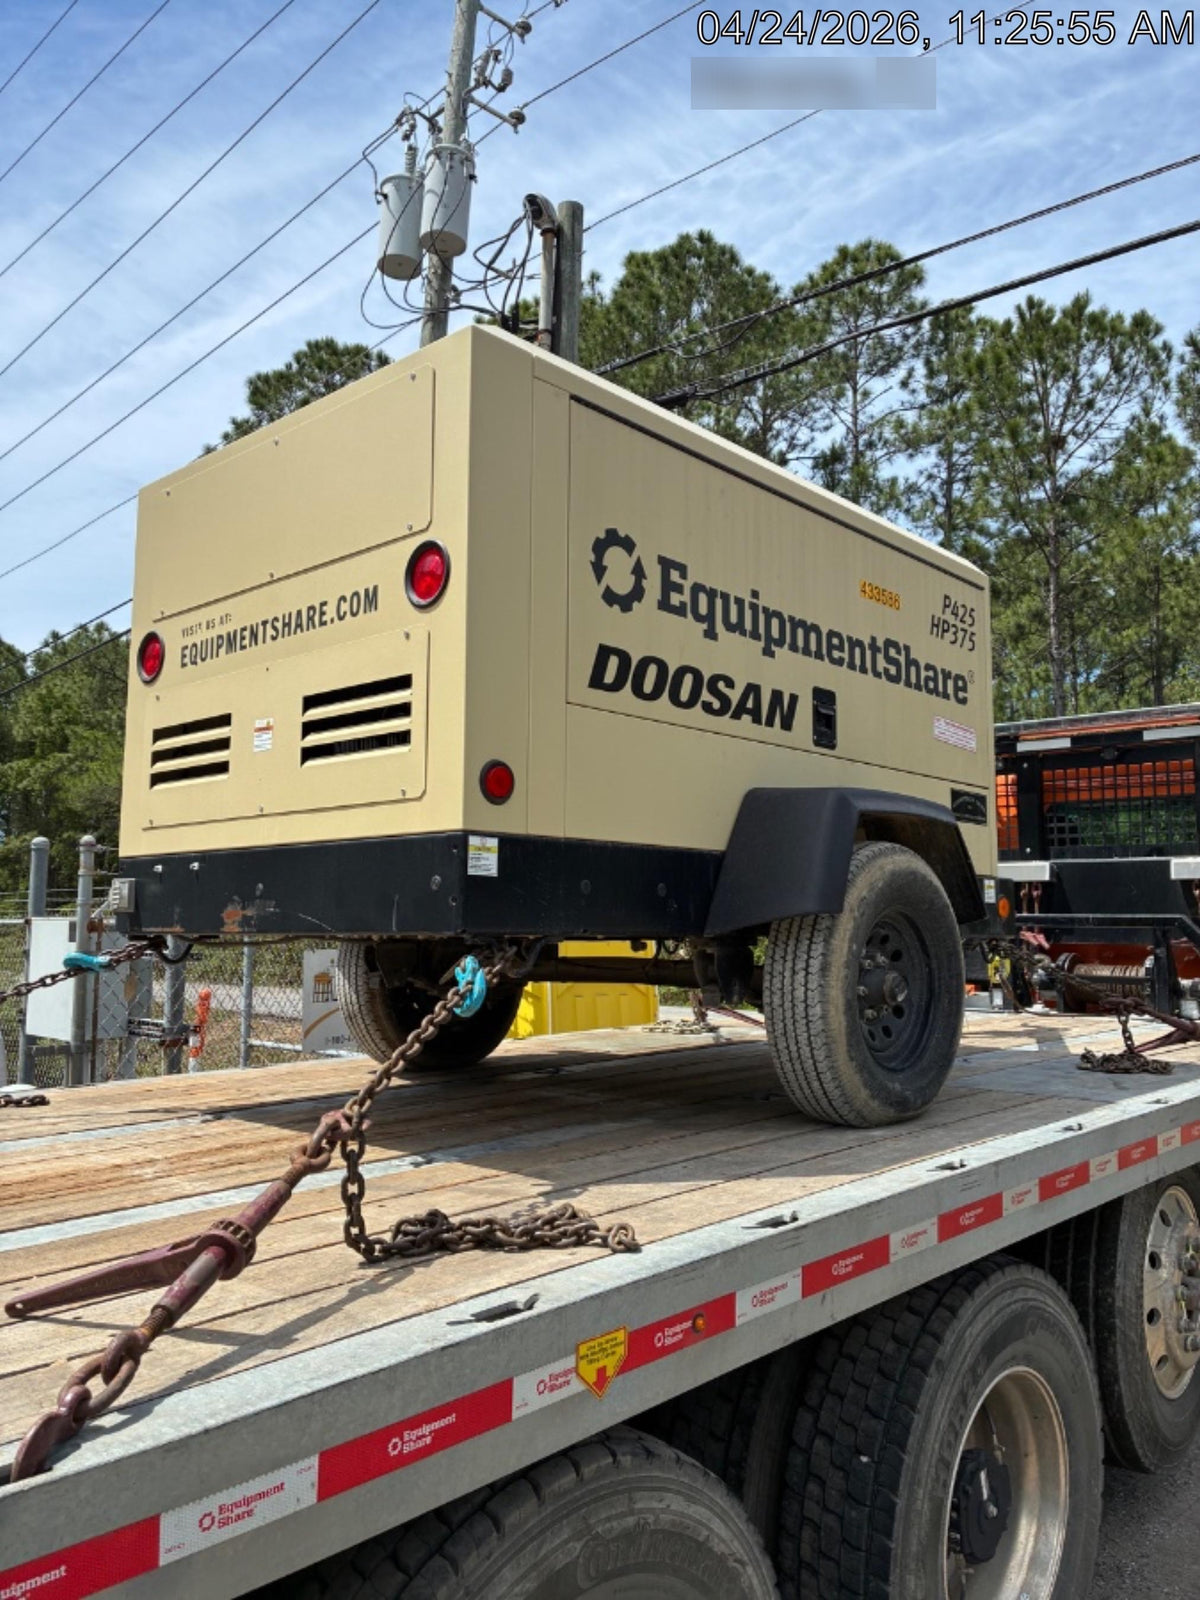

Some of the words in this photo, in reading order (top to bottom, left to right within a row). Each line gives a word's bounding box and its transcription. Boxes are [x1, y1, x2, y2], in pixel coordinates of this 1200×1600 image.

[180, 584, 379, 669] EQUIPMENTSHARE.COM
[942, 593, 974, 627] P425
[181, 622, 202, 639] VISIT
[206, 618, 216, 630] US
[657, 554, 968, 706] EquipmentShare
[930, 614, 976, 652] HP375
[588, 643, 799, 732] DOOSAN
[402, 1436, 432, 1454] Share
[403, 1413, 456, 1442] Equipment
[218, 1482, 285, 1517] Equipment
[217, 1507, 256, 1530] Share
[0, 1565, 67, 1600] uipment
